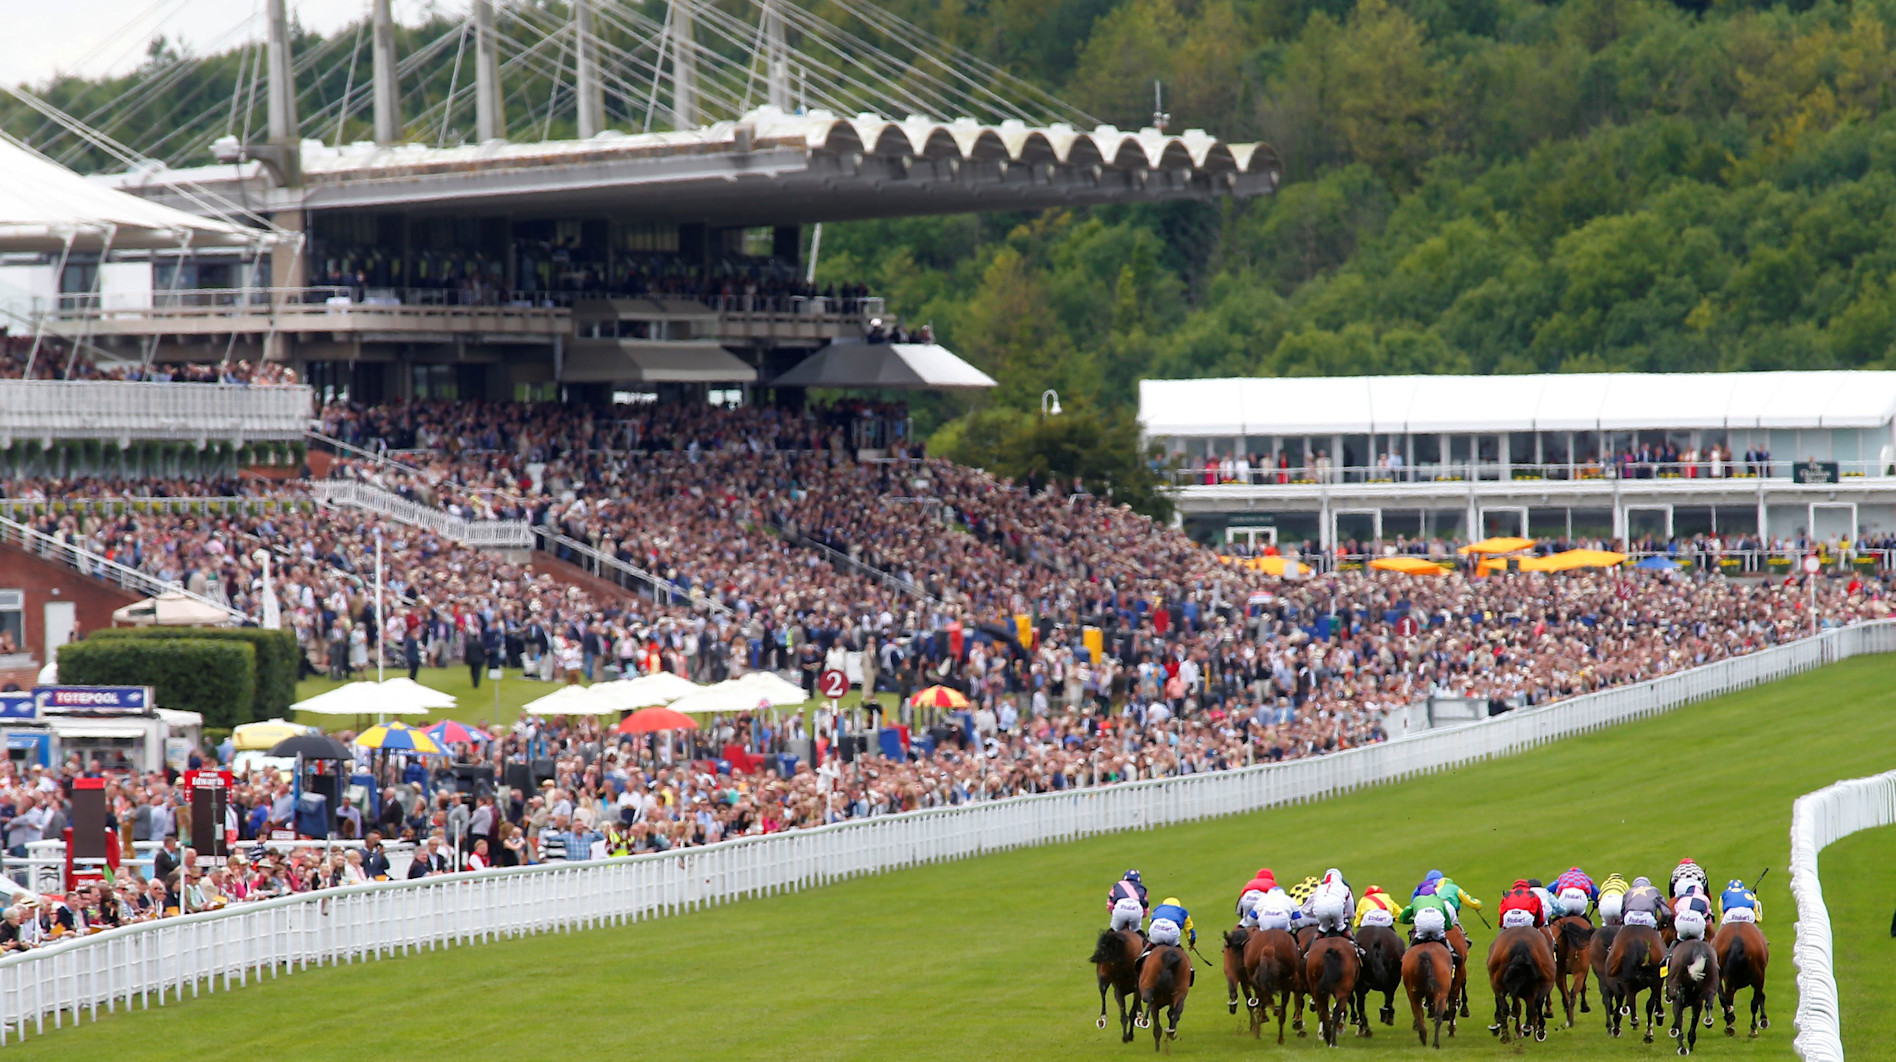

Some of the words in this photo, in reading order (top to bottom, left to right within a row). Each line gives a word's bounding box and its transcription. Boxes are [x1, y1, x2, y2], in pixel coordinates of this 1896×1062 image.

[1402, 618, 1411, 637] 1
[826, 671, 843, 696] 2
[56, 692, 120, 704] TOTEPOOL
[1628, 916, 1648, 924] Stobart
[1154, 924, 1172, 932] Stobart
